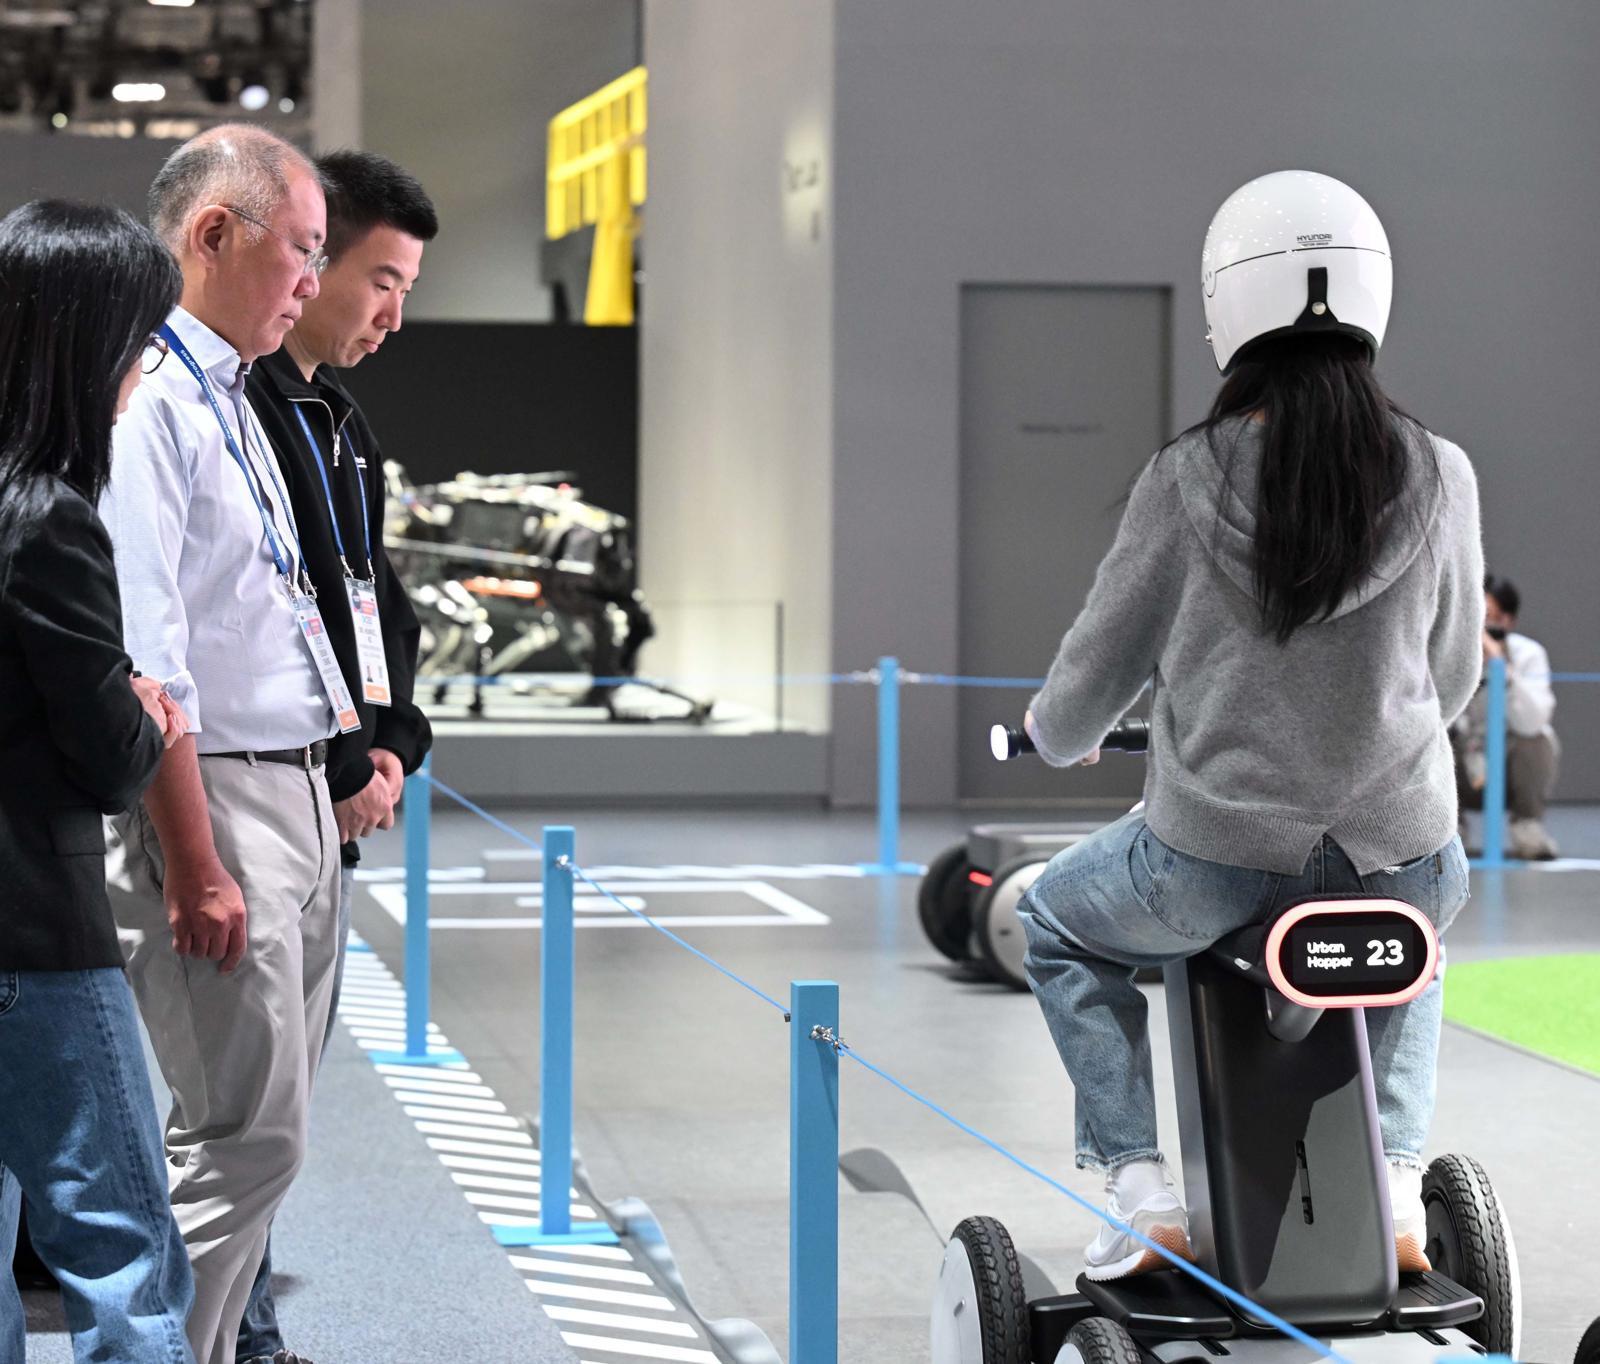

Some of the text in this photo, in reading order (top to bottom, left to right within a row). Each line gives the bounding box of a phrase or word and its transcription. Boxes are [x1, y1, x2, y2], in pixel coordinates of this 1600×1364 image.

[1297, 233, 1332, 242] HYUNDAI
[180, 349, 201, 377] Progress
[1307, 941, 1346, 954] Urban
[1366, 939, 1404, 966] 23
[1307, 956, 1354, 970] Hopper
